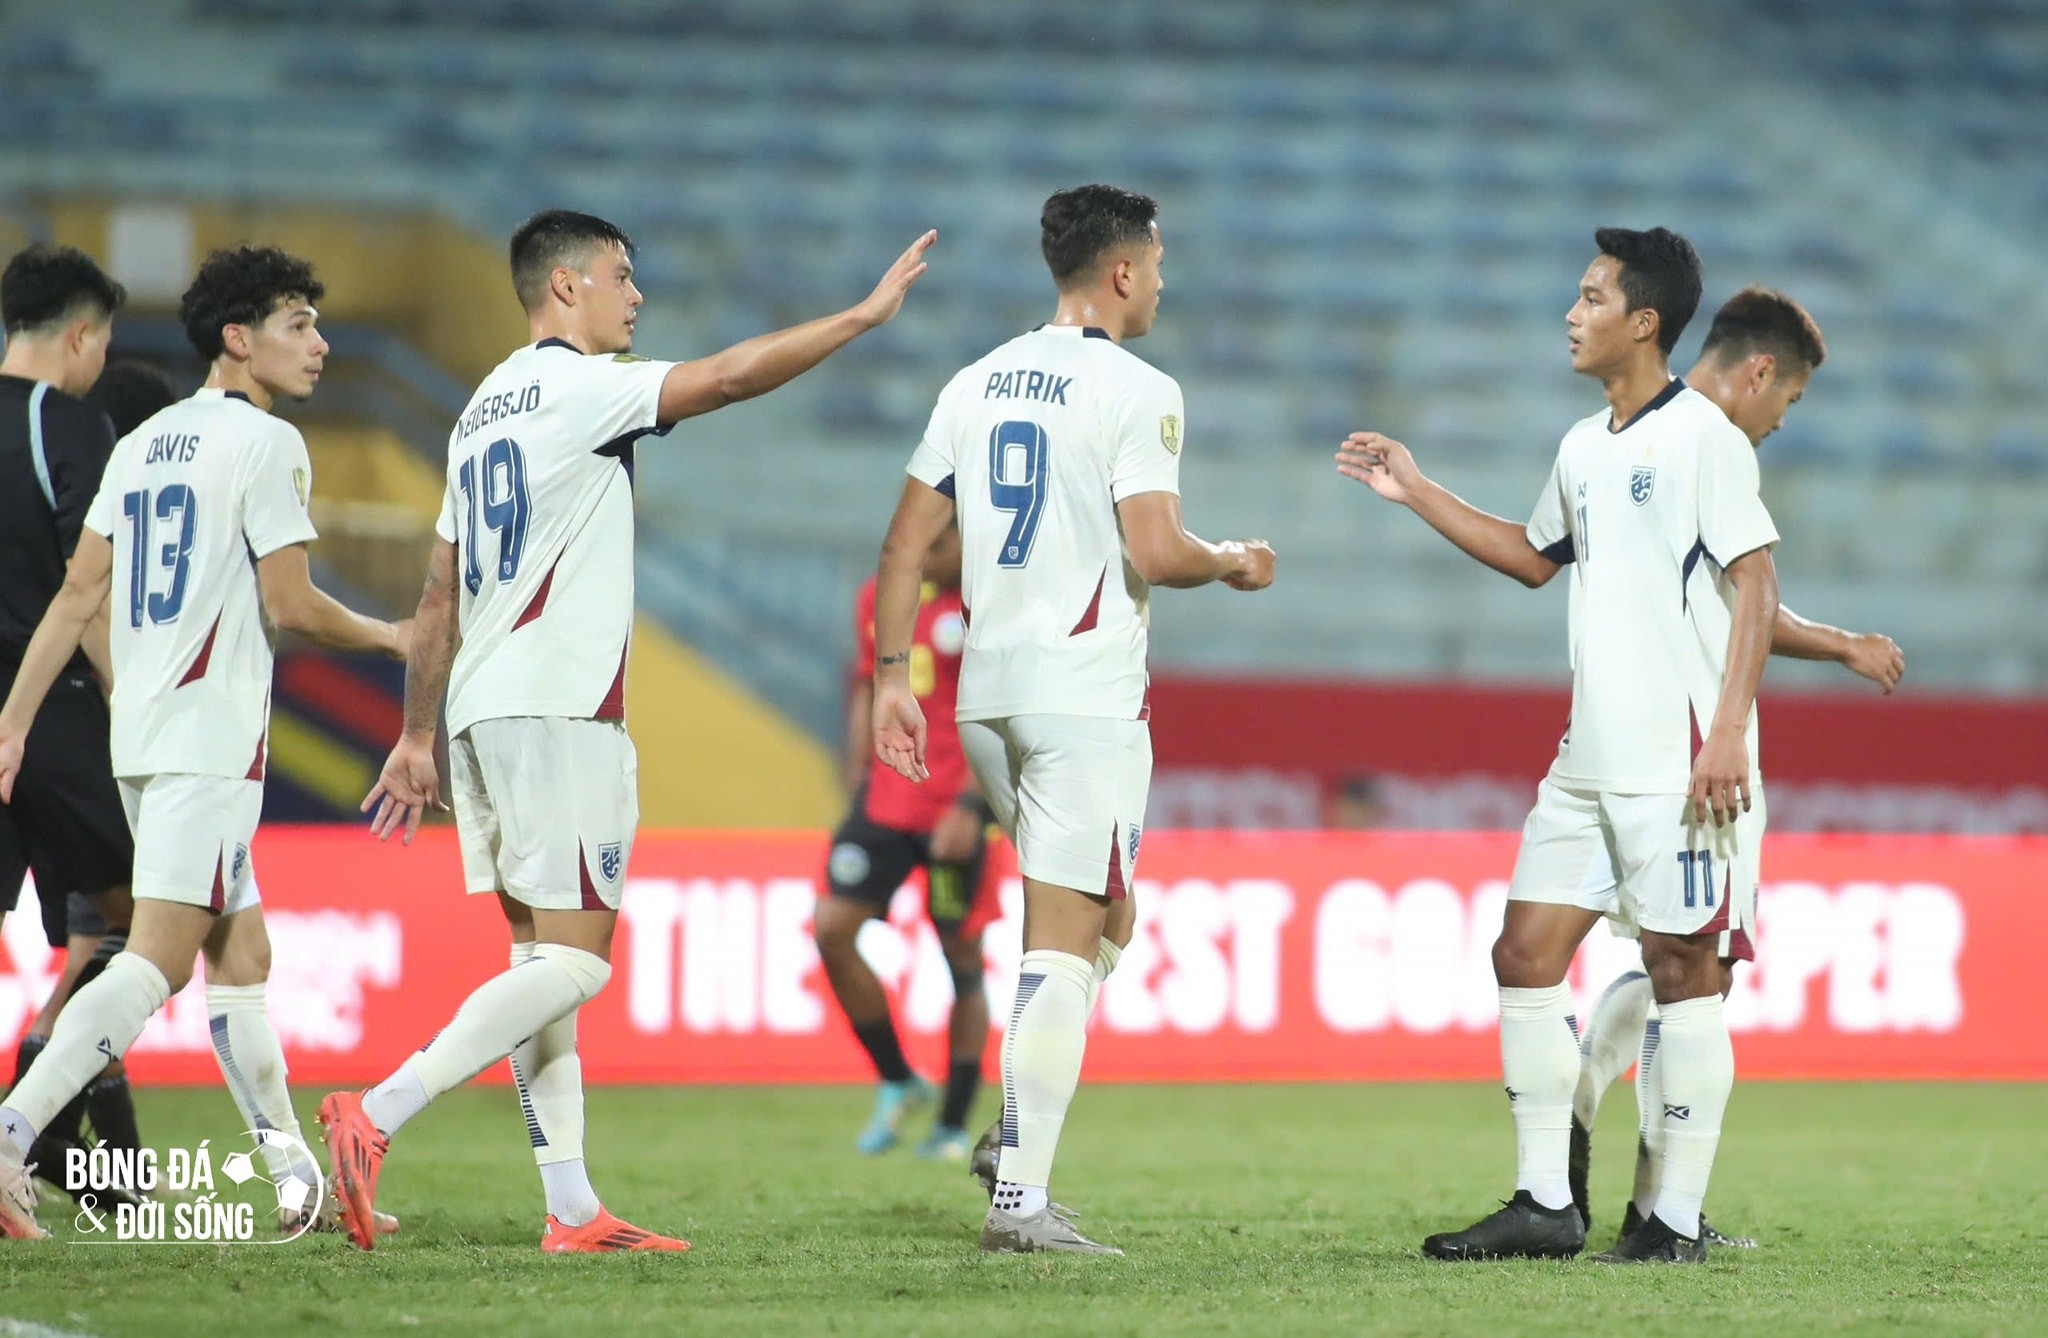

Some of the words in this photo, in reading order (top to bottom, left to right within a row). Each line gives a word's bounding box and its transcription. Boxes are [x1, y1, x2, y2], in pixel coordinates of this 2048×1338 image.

[145, 433, 200, 464] DAVIS
[984, 369, 1073, 406] PATRIK
[123, 483, 199, 632] 13
[459, 437, 532, 597] 19
[989, 420, 1049, 568] 9
[1677, 849, 1715, 909] 11
[622, 878, 824, 1032] THE
